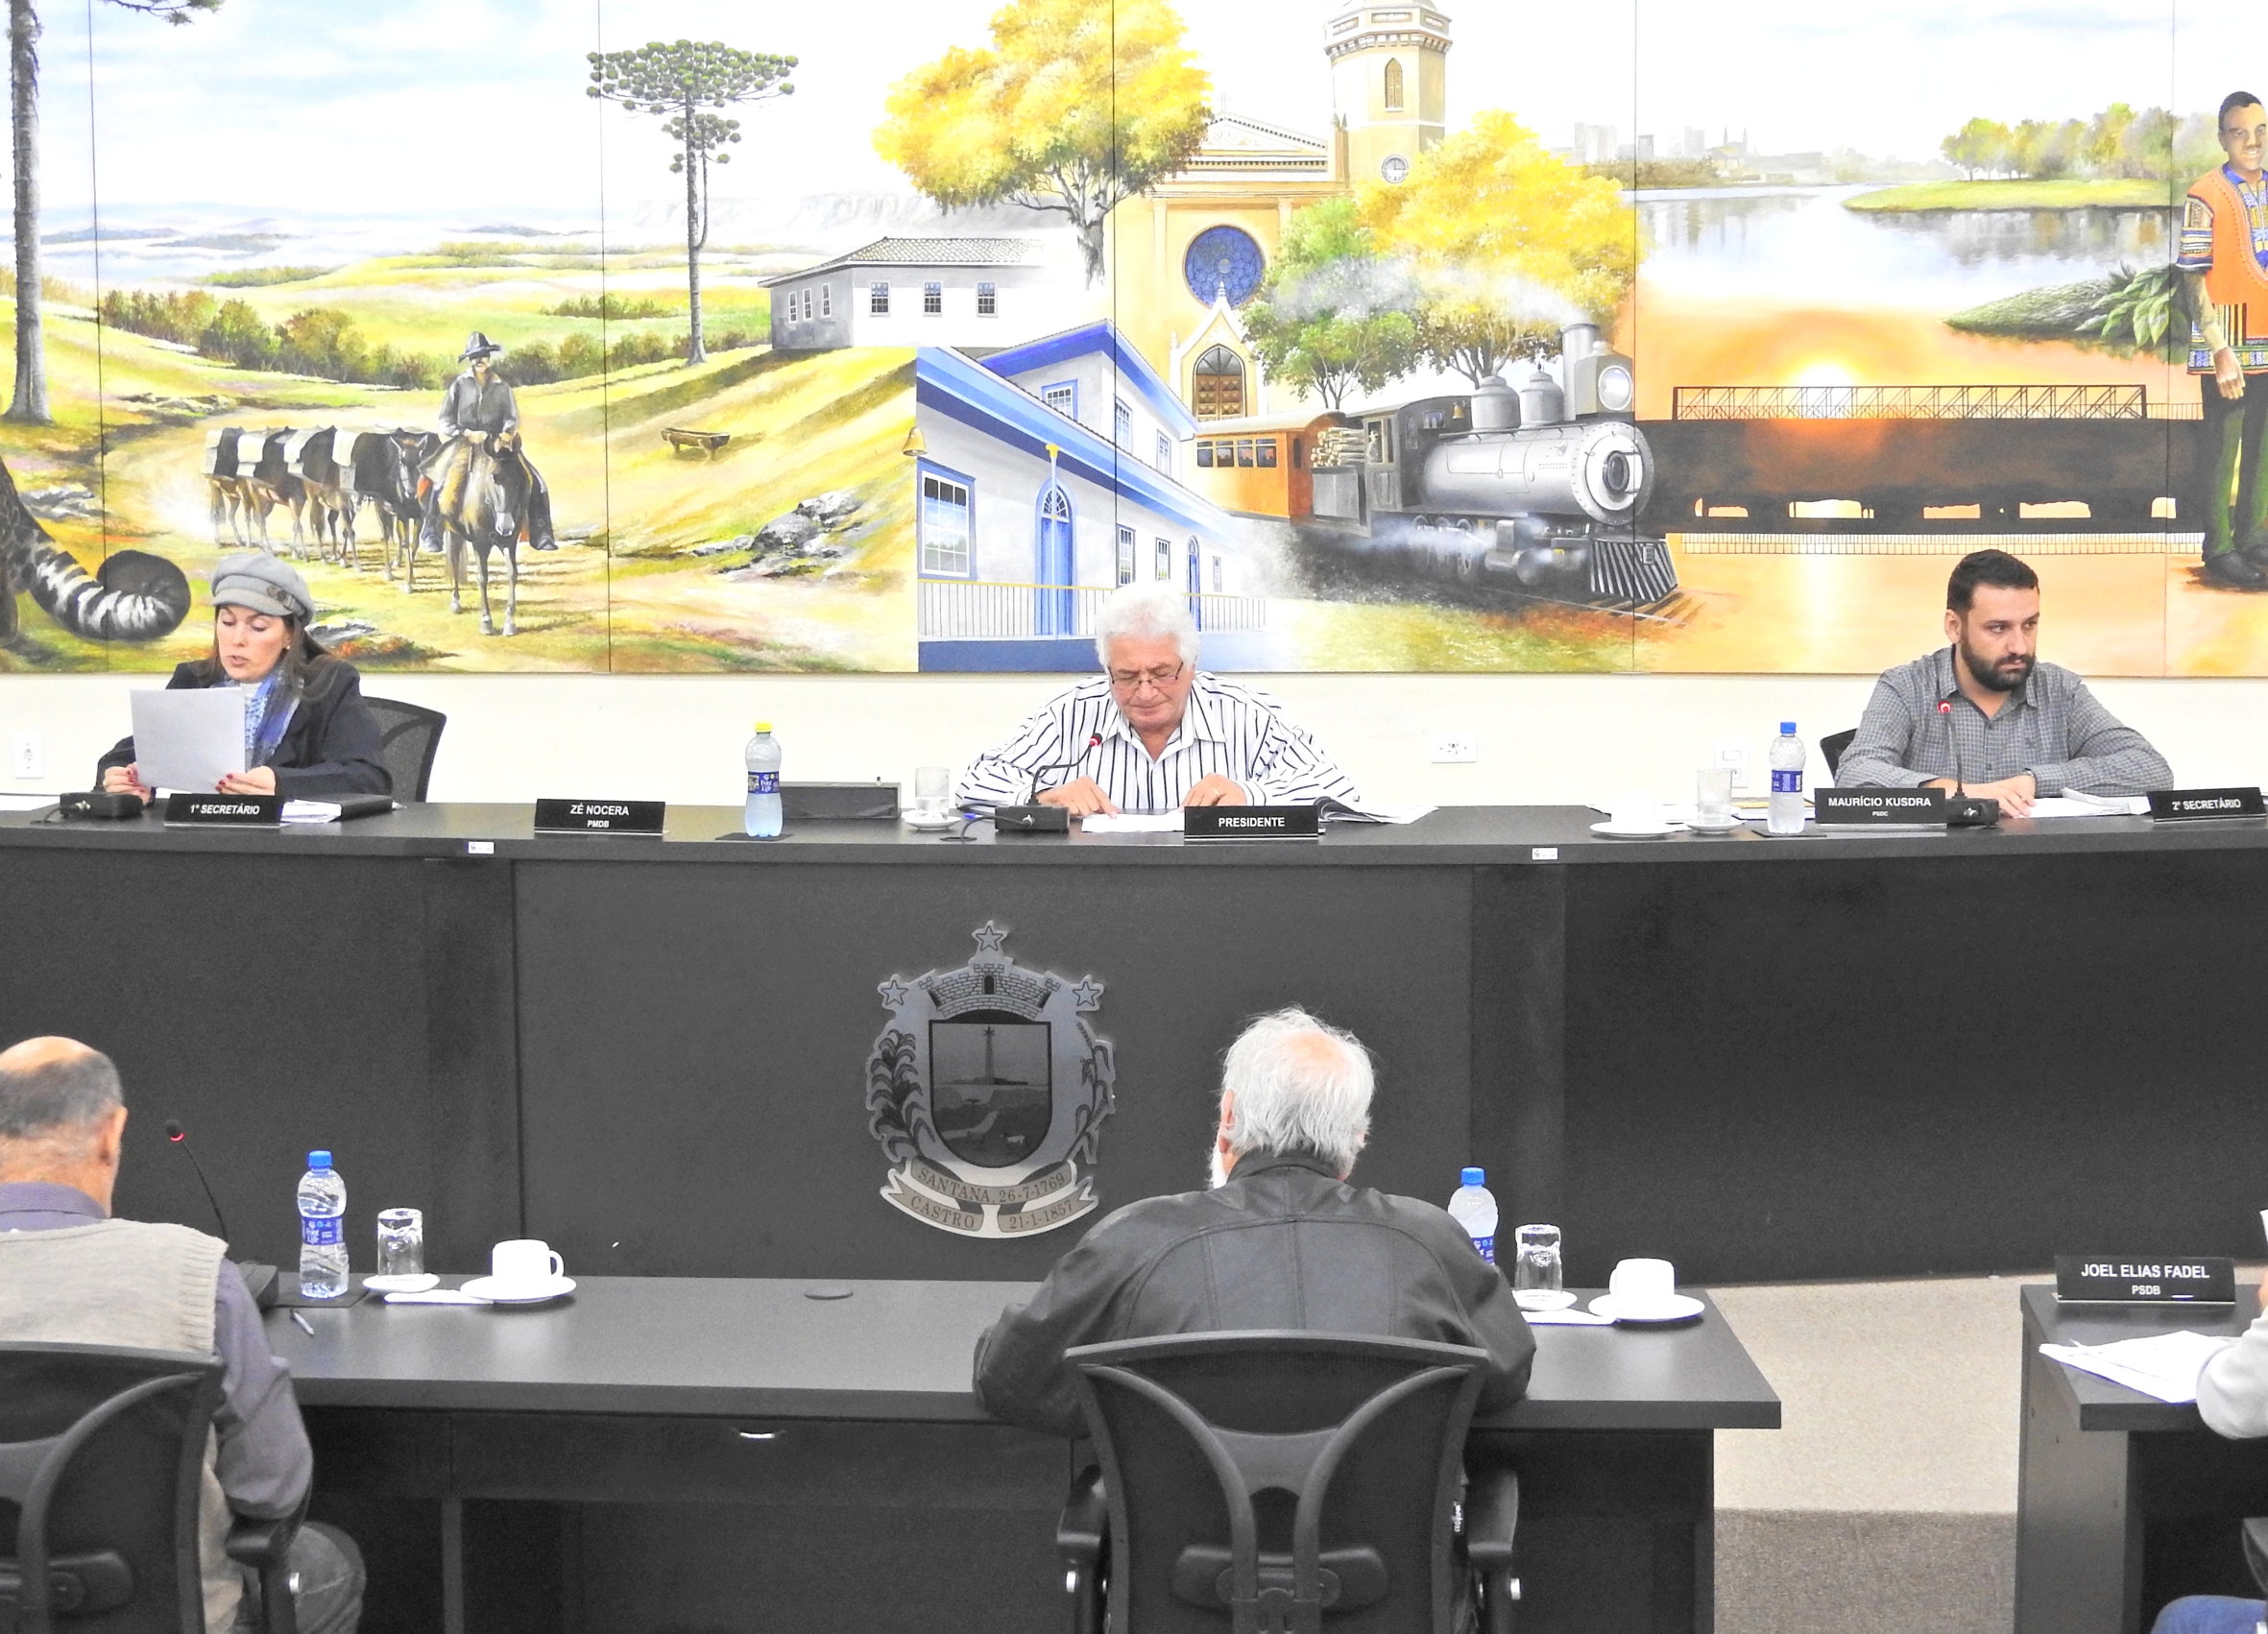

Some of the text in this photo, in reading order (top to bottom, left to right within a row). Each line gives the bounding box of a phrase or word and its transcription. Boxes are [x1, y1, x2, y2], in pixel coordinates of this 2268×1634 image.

[1828, 796, 1932, 807] MAURÍCIO KUSDRA
[2183, 797, 2242, 810] SECRETÁRIO
[200, 804, 260, 815] SECRETÁRIO
[569, 803, 630, 816] ZÉ NOCERA
[587, 820, 610, 829] PMDB
[1218, 817, 1286, 828] PRESIDENTE
[911, 1194, 976, 1229] CASTRO
[2081, 1263, 2210, 1279] JOEL ELIAS FADEL
[2132, 1285, 2160, 1295] PSDB
